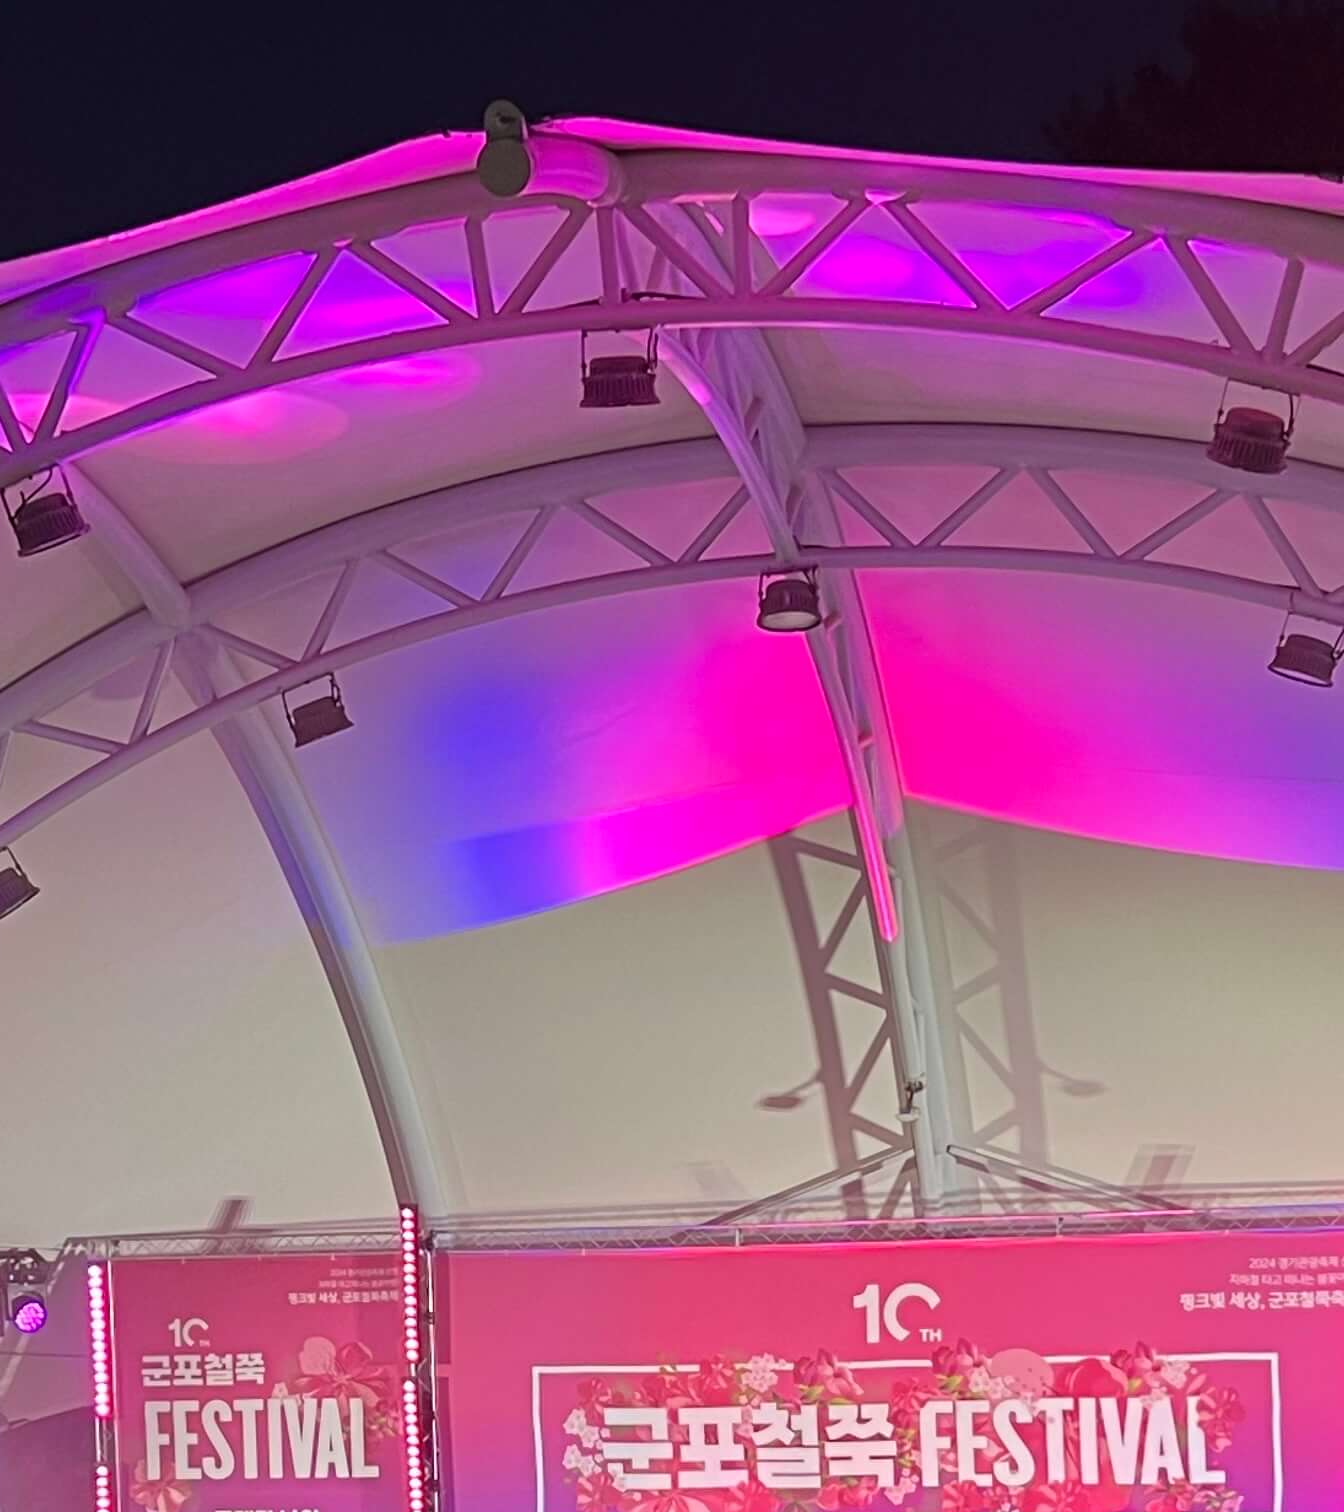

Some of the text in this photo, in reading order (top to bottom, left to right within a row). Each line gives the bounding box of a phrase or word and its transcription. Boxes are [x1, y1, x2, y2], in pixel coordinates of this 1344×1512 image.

[1229, 1291, 1266, 1311] 세상,
[141, 1353, 266, 1387] 군포철쭉
[144, 1397, 380, 1481] FESTIVAL
[601, 1395, 1227, 1491] 군포철쭉 FESTIVAL
